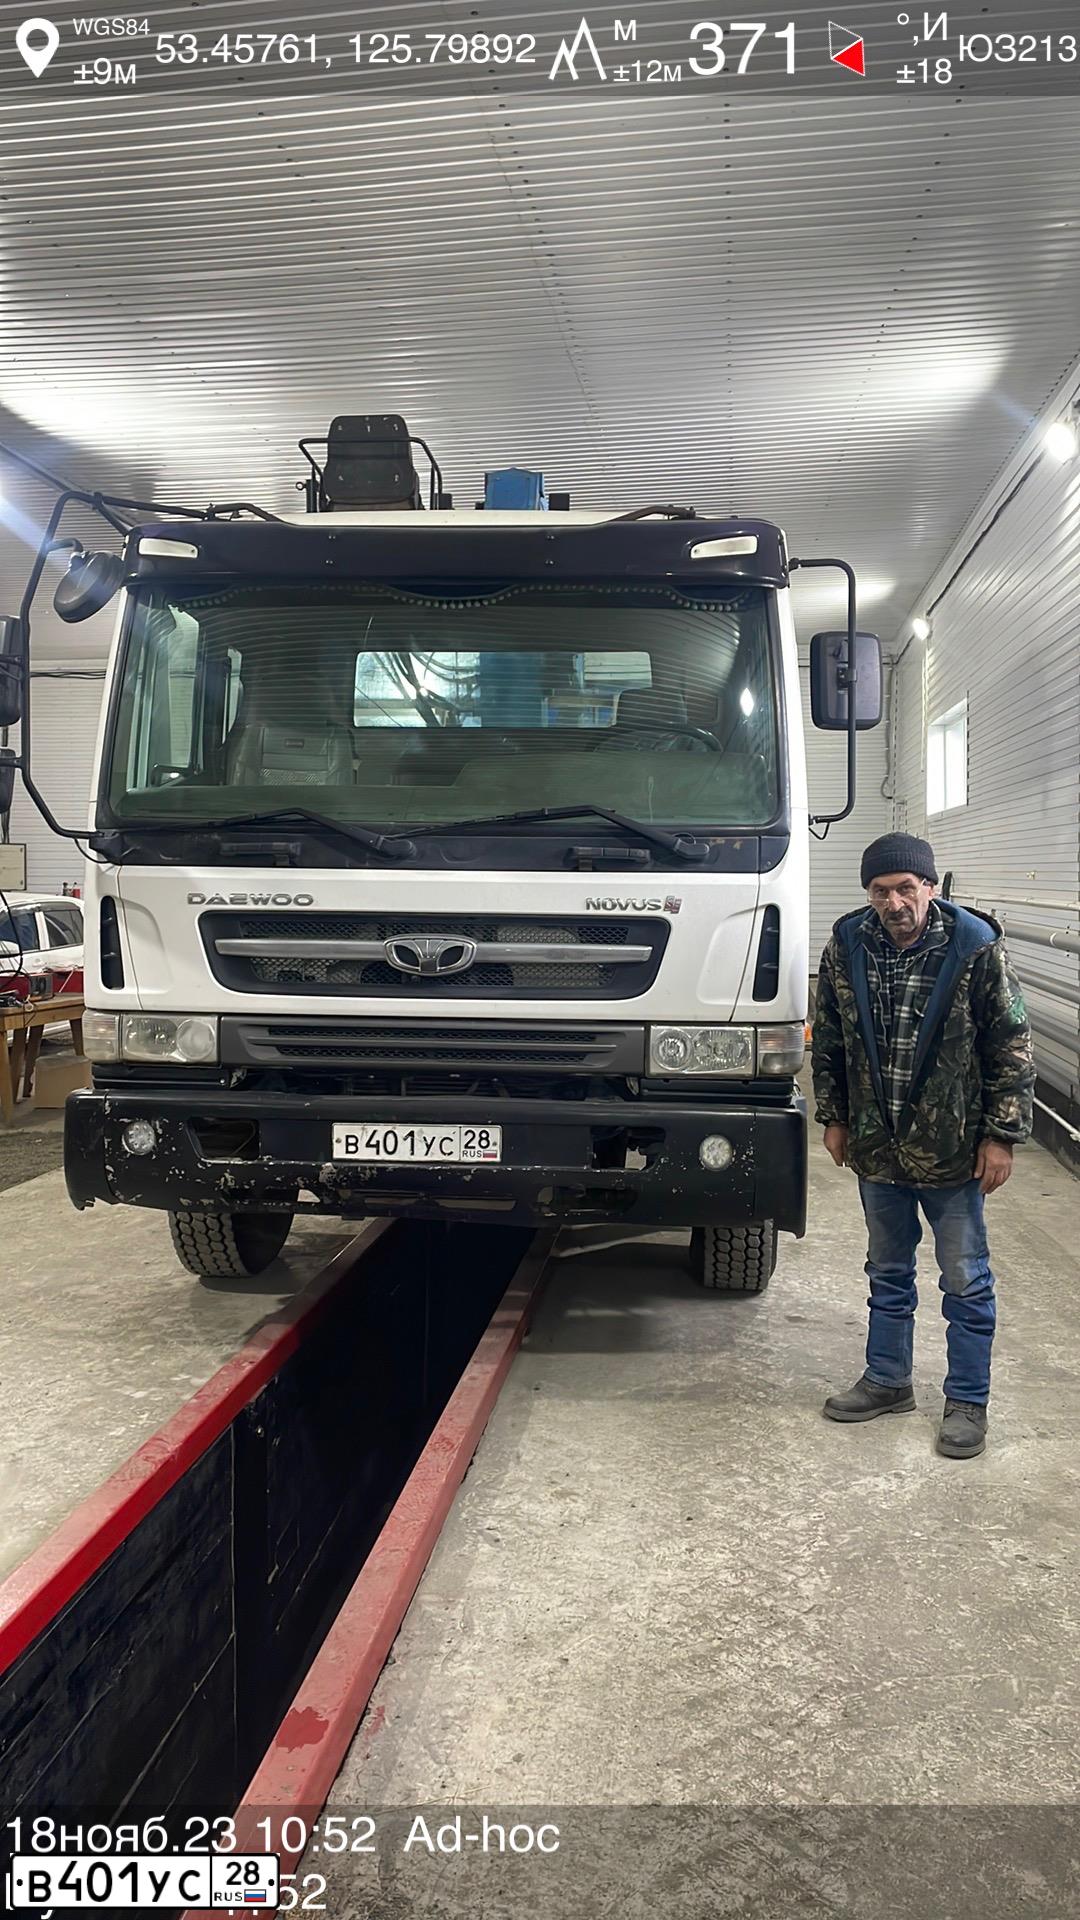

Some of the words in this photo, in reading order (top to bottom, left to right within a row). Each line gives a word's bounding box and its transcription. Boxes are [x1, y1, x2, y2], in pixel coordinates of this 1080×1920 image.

[187, 893, 314, 906] DAEWOO
[585, 897, 662, 911] NOVUS
[345, 1129, 454, 1156] В401УС
[463, 1129, 491, 1150] 28
[462, 1150, 482, 1158] RUS
